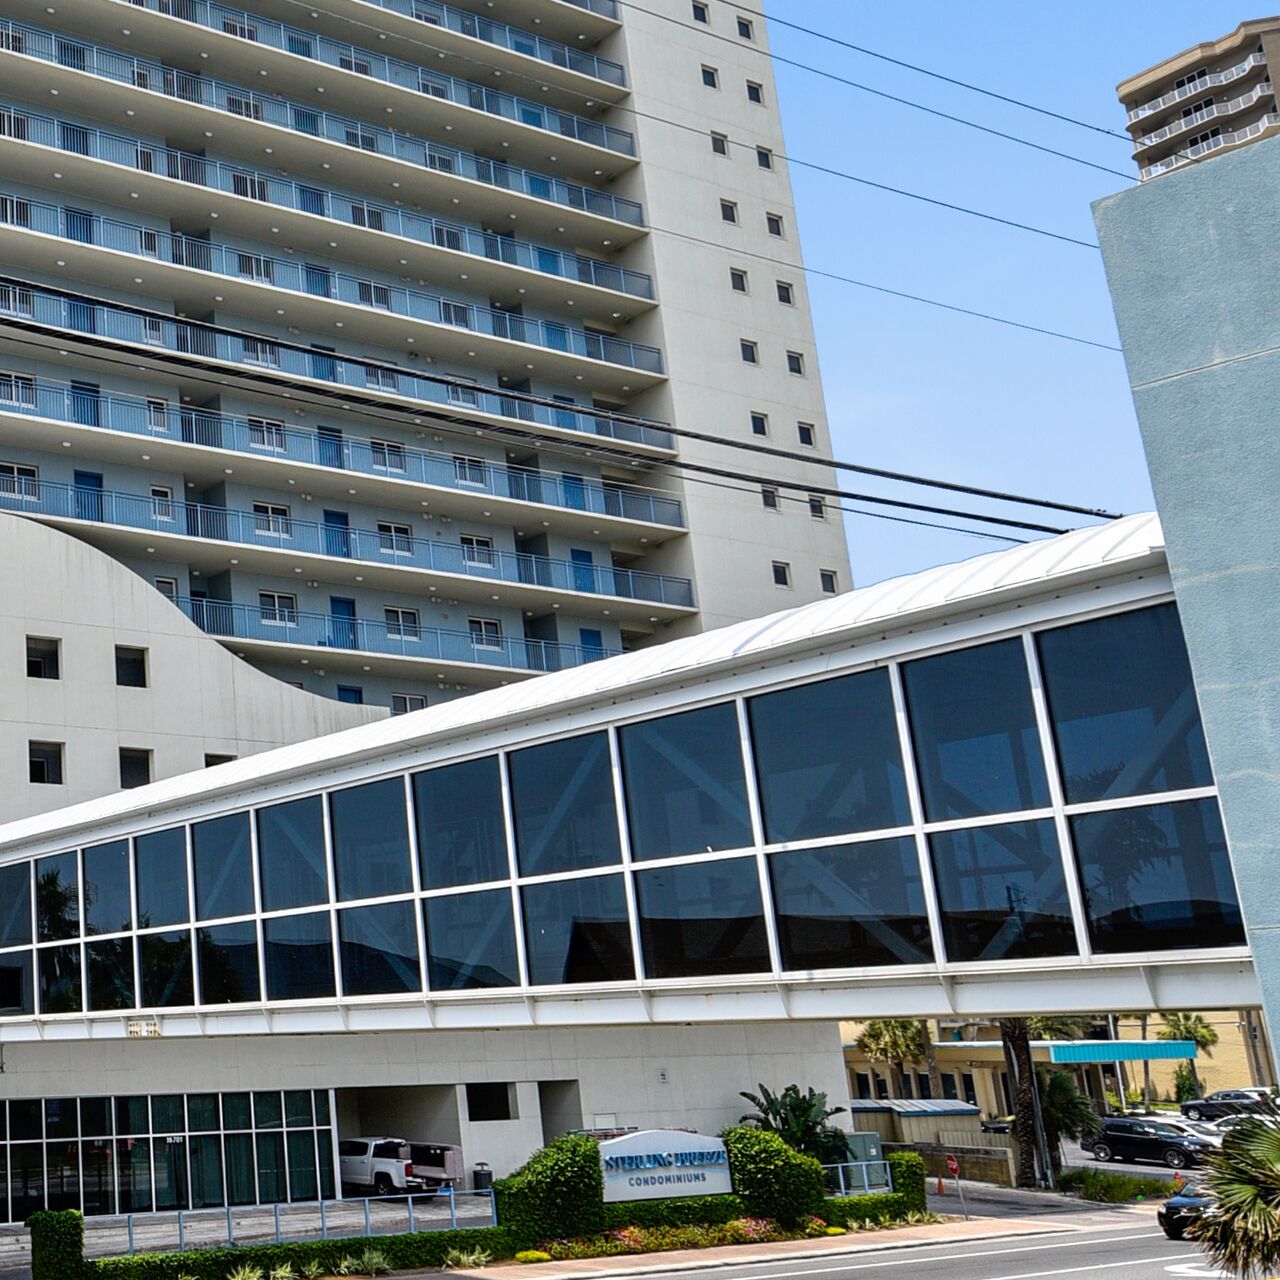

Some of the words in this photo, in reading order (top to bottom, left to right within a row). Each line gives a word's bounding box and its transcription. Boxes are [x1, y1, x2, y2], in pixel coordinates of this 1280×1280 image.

[604, 1153, 672, 1169] STERLING
[674, 1150, 726, 1166] BREEZE
[628, 1173, 706, 1187] CONDOMINIUMS
